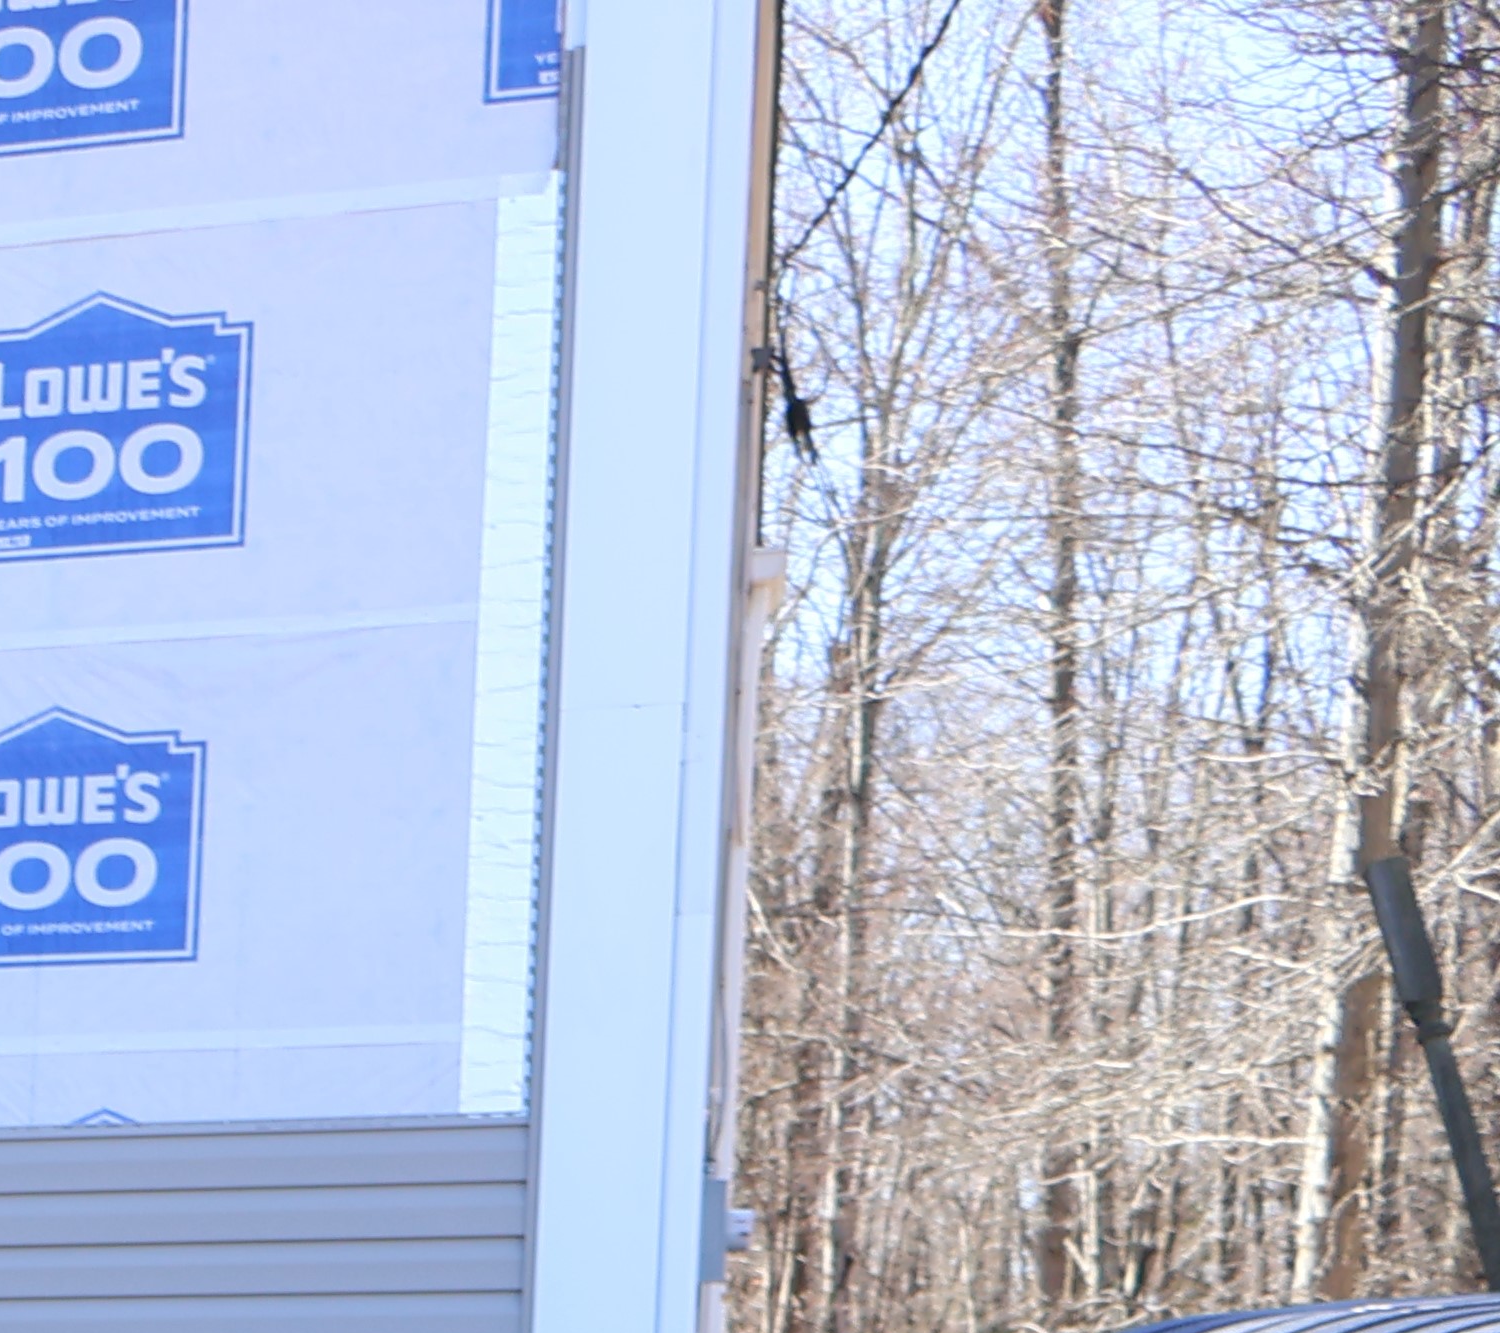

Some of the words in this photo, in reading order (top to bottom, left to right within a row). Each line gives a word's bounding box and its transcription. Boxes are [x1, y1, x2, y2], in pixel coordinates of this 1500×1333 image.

[11, 98, 140, 124] IMPROVEMENT
[44, 514, 69, 528] OF
[71, 505, 201, 526] IMPROVEMENT
[1, 923, 25, 936] OF
[27, 919, 154, 935] IMPROVEMENT
